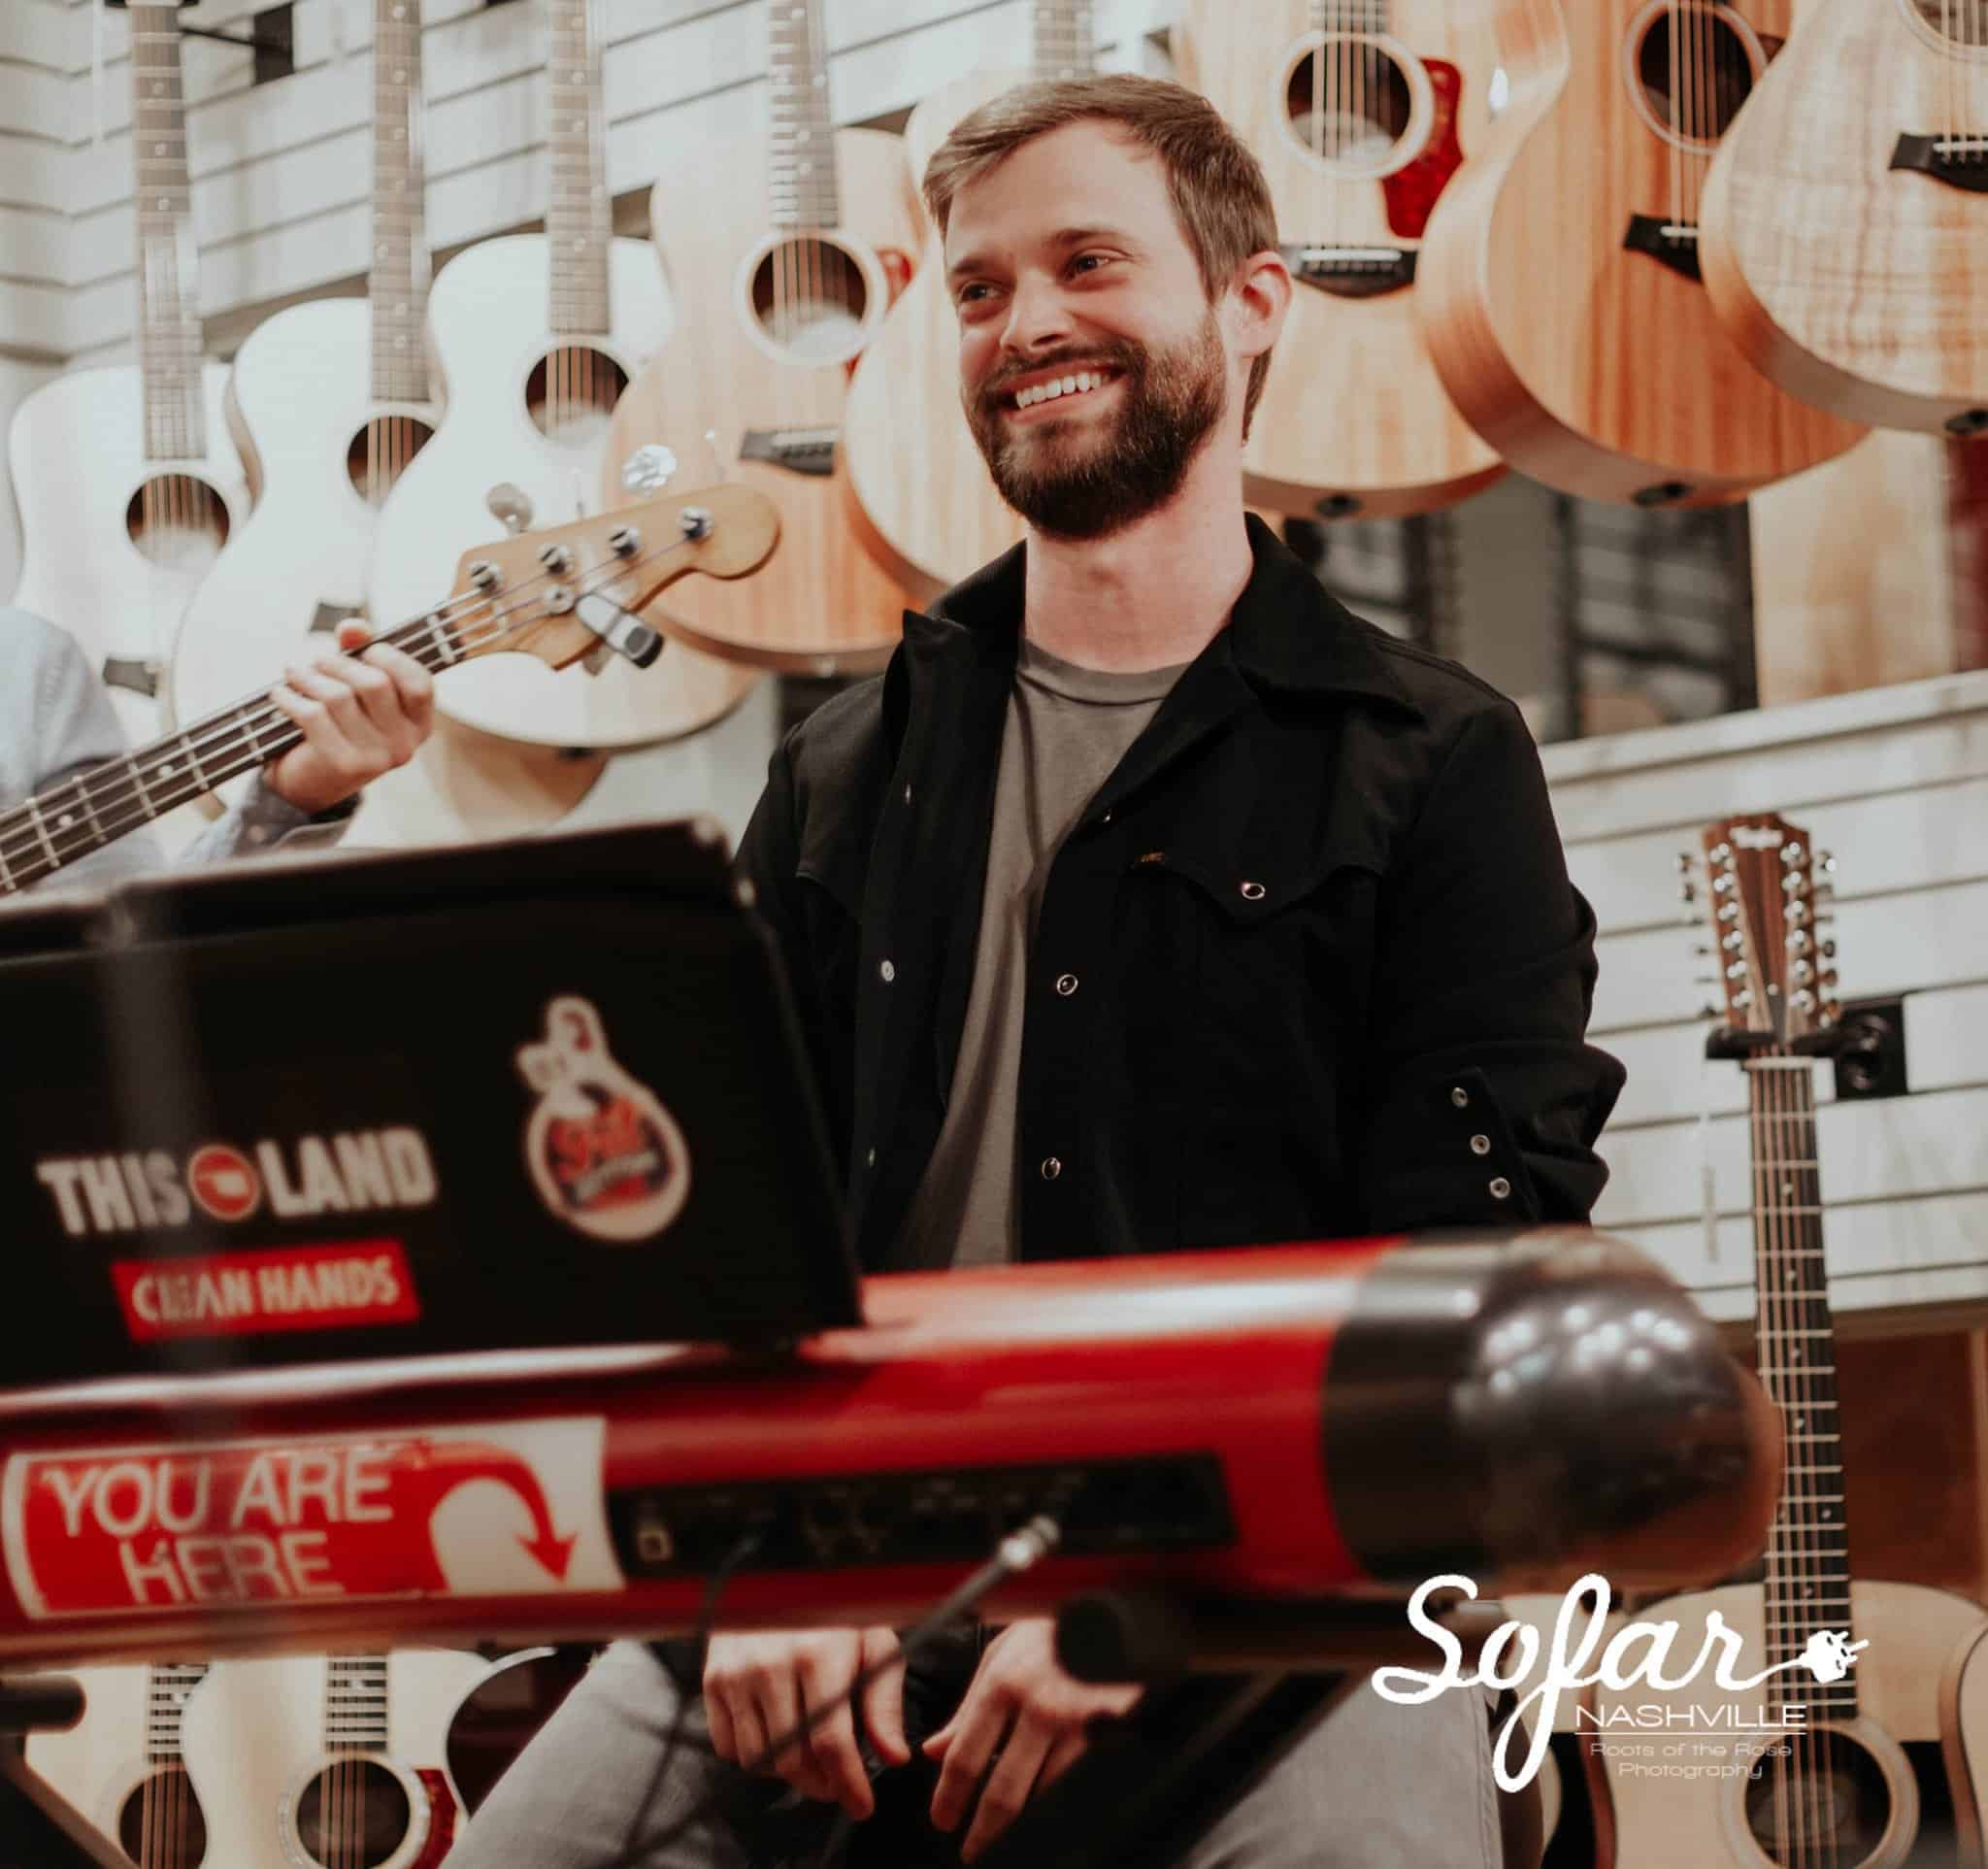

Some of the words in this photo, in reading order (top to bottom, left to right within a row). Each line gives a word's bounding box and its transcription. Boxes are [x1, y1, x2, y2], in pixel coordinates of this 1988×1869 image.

[36, 1154, 190, 1235] THIS
[256, 1126, 437, 1218] LAND
[260, 1255, 400, 1315] HANDS
[41, 1461, 210, 1536] YOU
[229, 1447, 394, 1524] ARE
[118, 1531, 346, 1604] HERE
